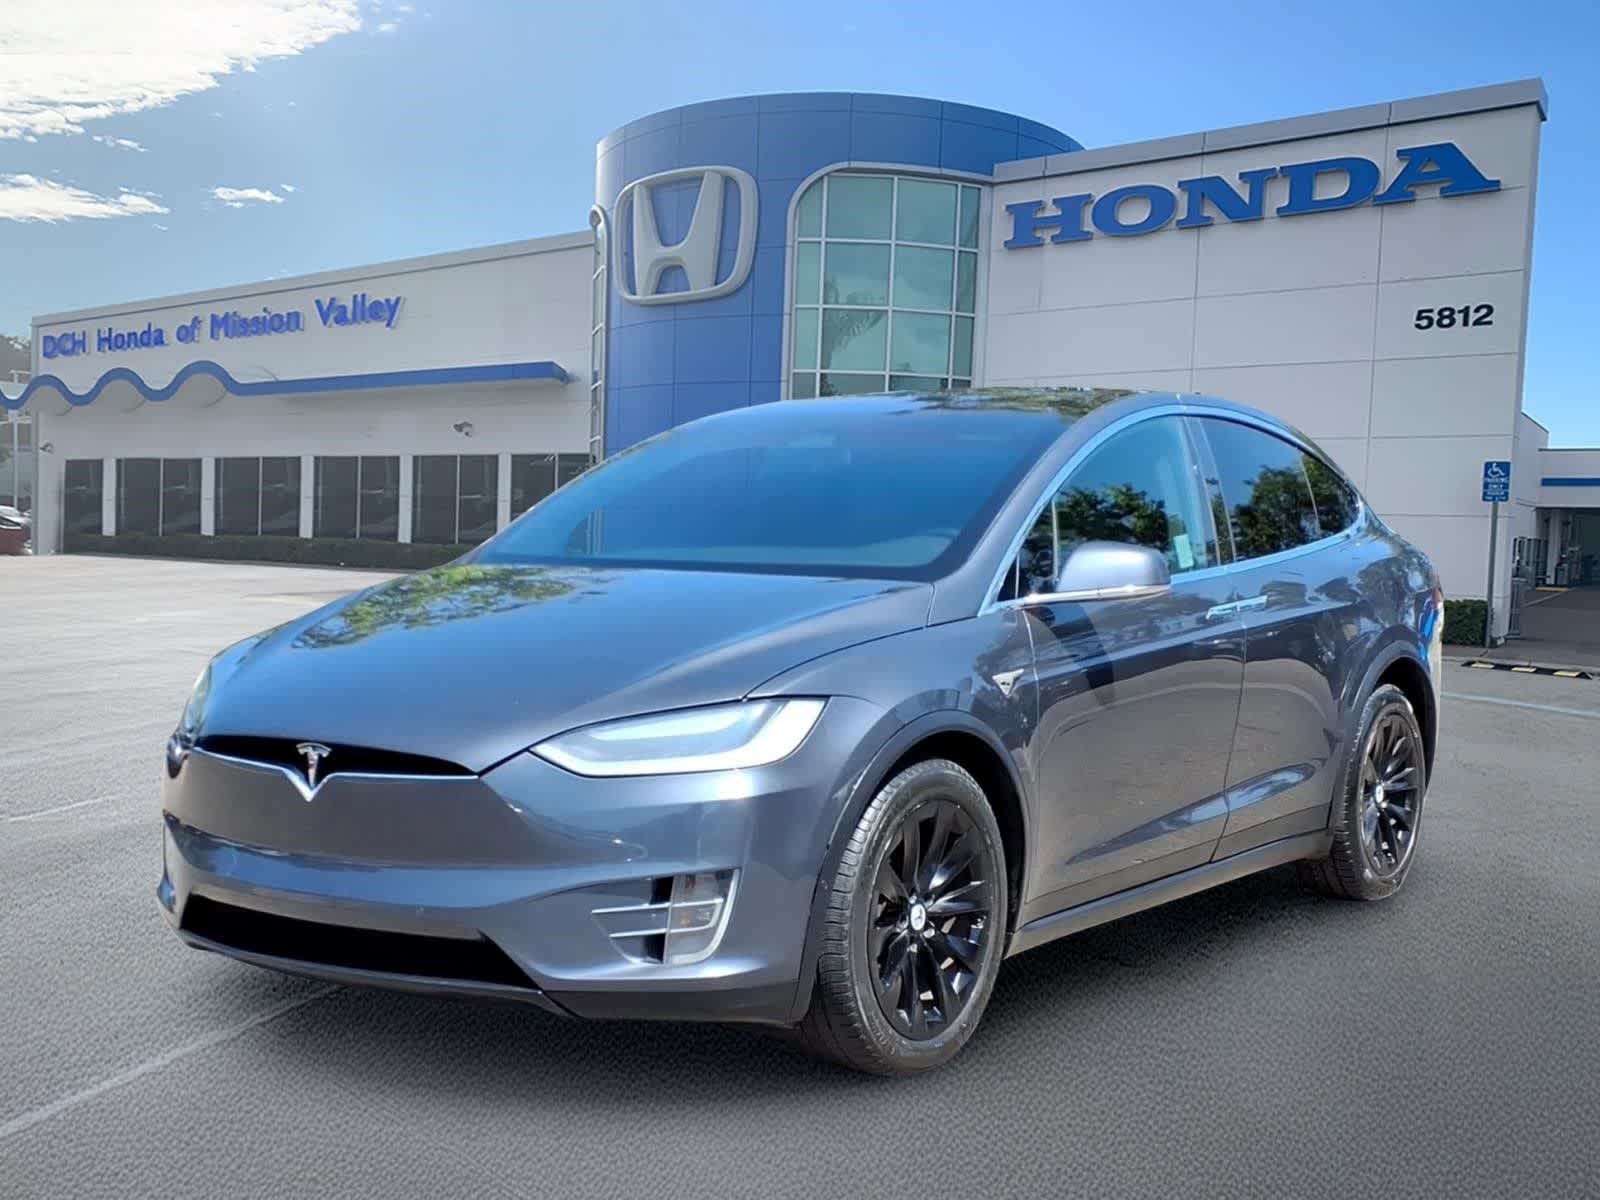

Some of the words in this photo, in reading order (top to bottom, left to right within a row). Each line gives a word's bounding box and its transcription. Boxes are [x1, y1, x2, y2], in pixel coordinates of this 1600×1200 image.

[1004, 142, 1501, 250] HONDA
[42, 329, 87, 359] DCH
[97, 322, 166, 352] Honda
[176, 315, 202, 344] of
[210, 306, 304, 340] Mission
[314, 293, 402, 329] Valley
[1414, 303, 1495, 331] 5812
